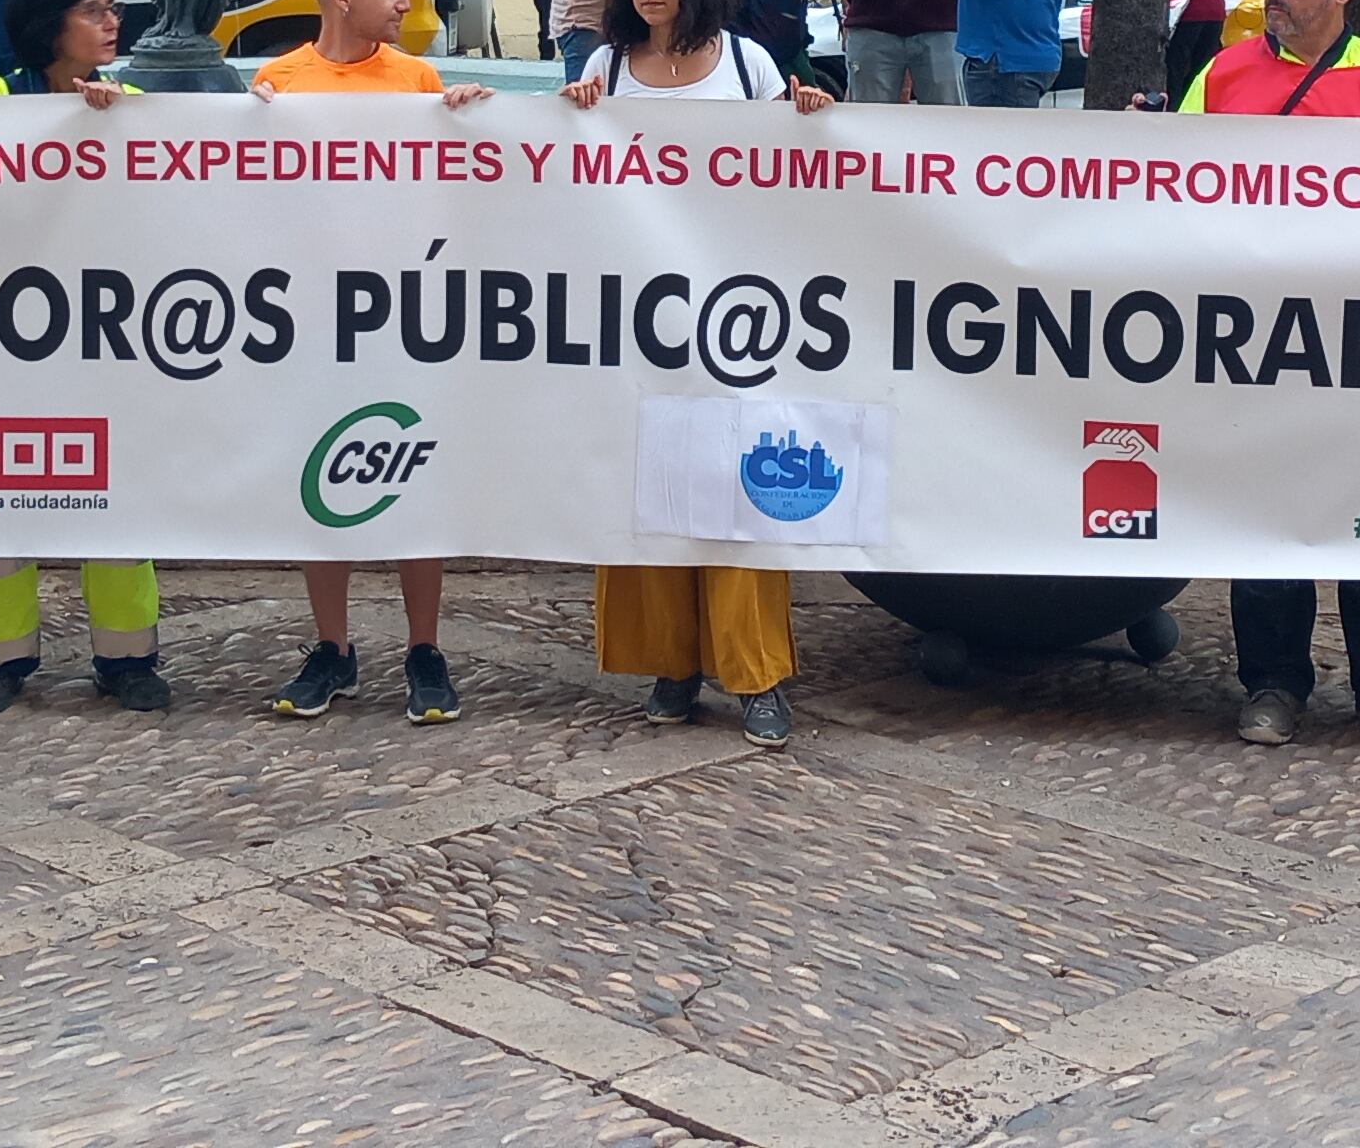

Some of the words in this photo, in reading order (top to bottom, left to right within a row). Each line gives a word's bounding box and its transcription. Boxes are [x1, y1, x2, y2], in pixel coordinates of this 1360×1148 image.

[127, 139, 503, 182] EXPEDIENTES
[522, 142, 555, 182] Y
[572, 132, 689, 186] MÁS
[708, 145, 956, 194] CUMPLIR
[336, 238, 851, 389] PÚBLIC@S
[326, 440, 439, 486] CSIF
[746, 445, 838, 491] CSL
[10, 493, 109, 510] ciudadanía
[1088, 508, 1153, 535] CGT
